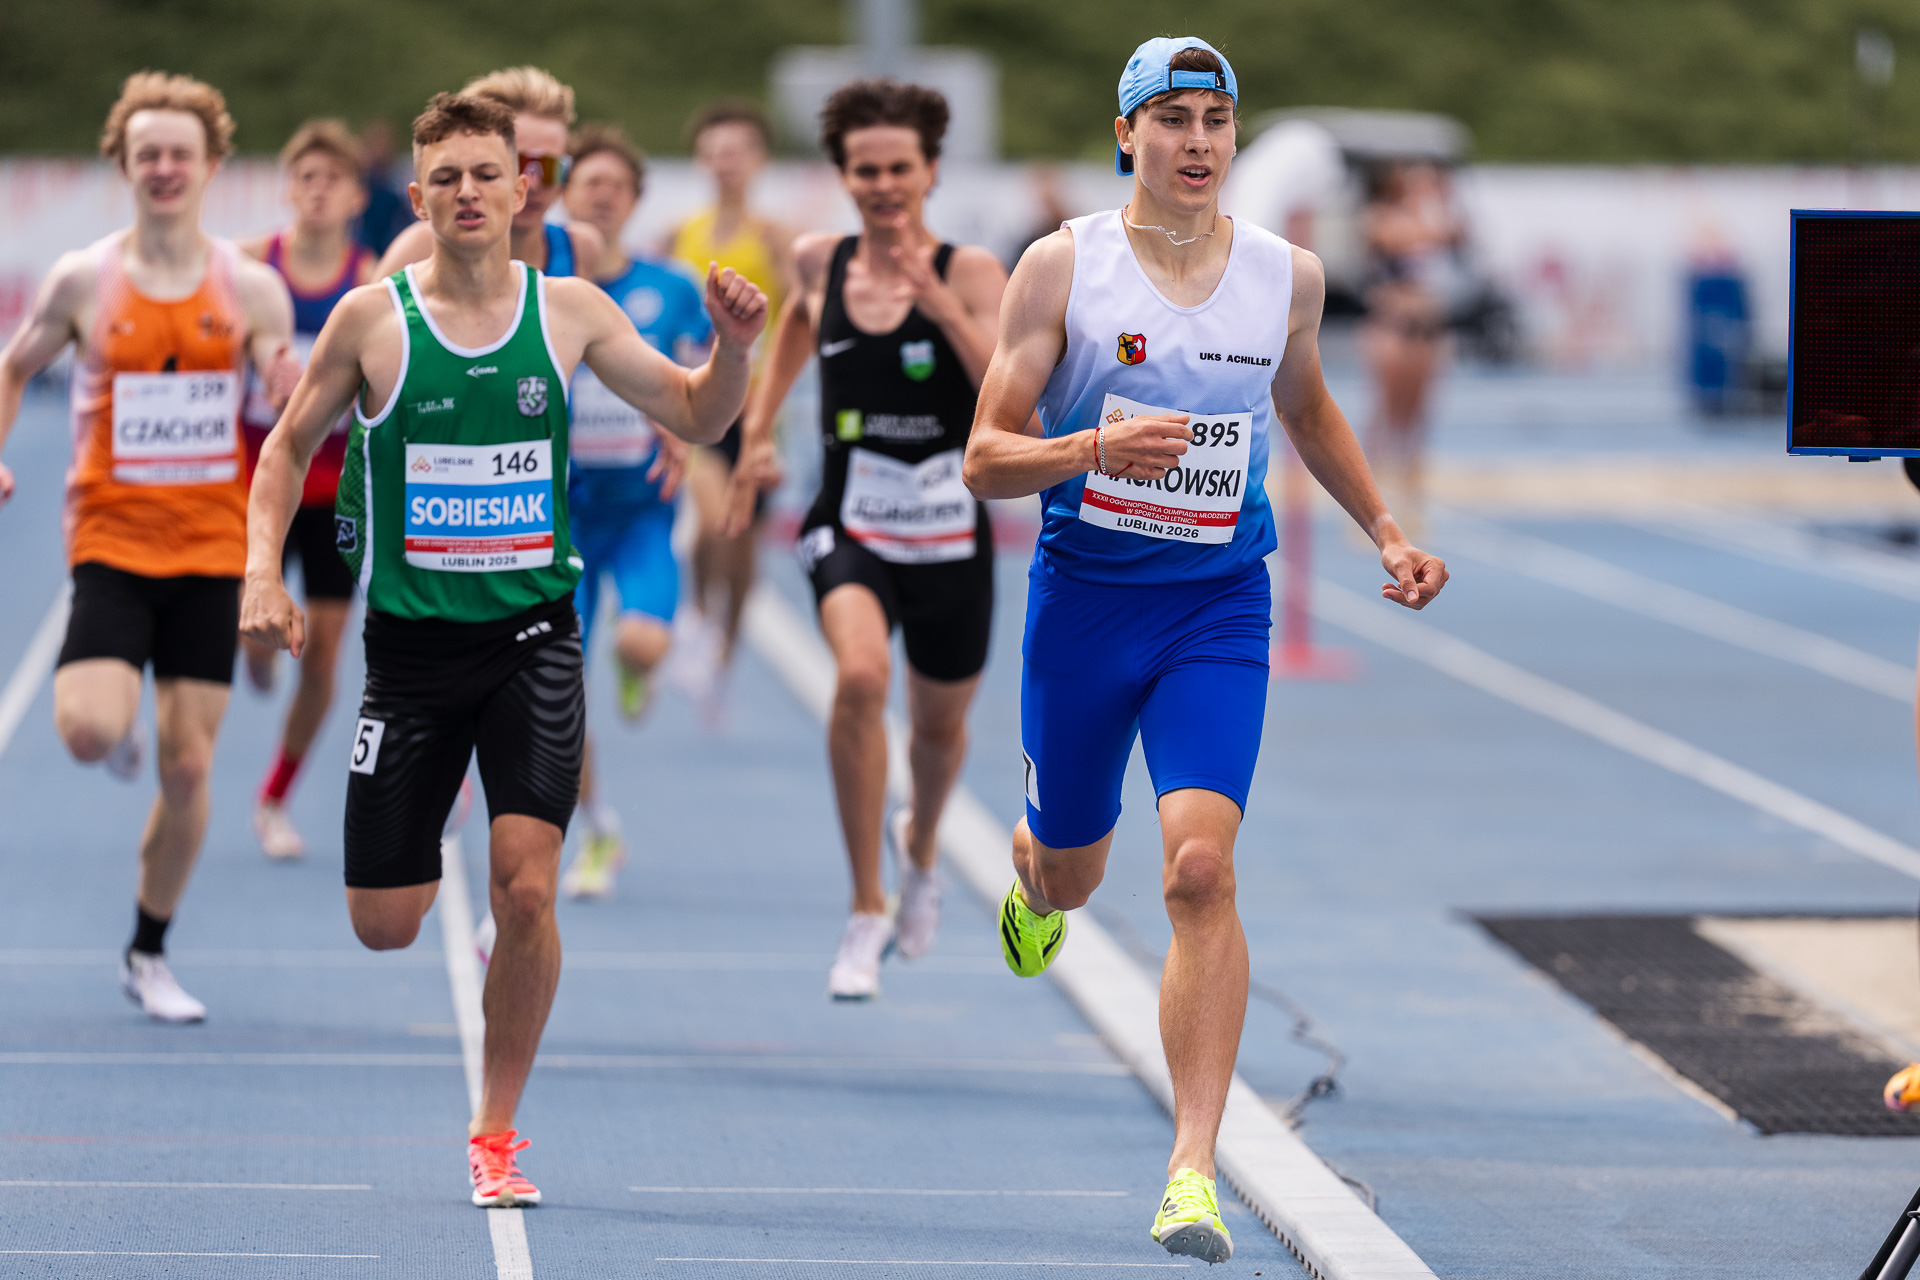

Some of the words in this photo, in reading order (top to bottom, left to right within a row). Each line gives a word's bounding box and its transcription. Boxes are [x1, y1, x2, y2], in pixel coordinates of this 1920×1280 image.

[1199, 352, 1222, 361] UKS
[1226, 354, 1272, 366] ACHILLES
[1190, 421, 1240, 448] 895
[492, 449, 538, 476] 146
[1094, 466, 1241, 498] OWSKI
[411, 492, 547, 527] SOBIESIAK
[1092, 492, 1109, 503] XXXII
[1109, 497, 1162, 513] OGÓLNOPOLSKA
[1163, 508, 1198, 519] OLIMPIADA
[1198, 512, 1232, 520] MŁODZIEŻY
[1134, 509, 1170, 522] SPORTACH
[1170, 516, 1198, 525] LETNICH
[1116, 517, 1164, 534] LUBLIN
[1165, 525, 1199, 539] 2026
[442, 556, 485, 567] LUBLIN
[488, 555, 518, 567] 2026
[354, 723, 374, 767] 5
